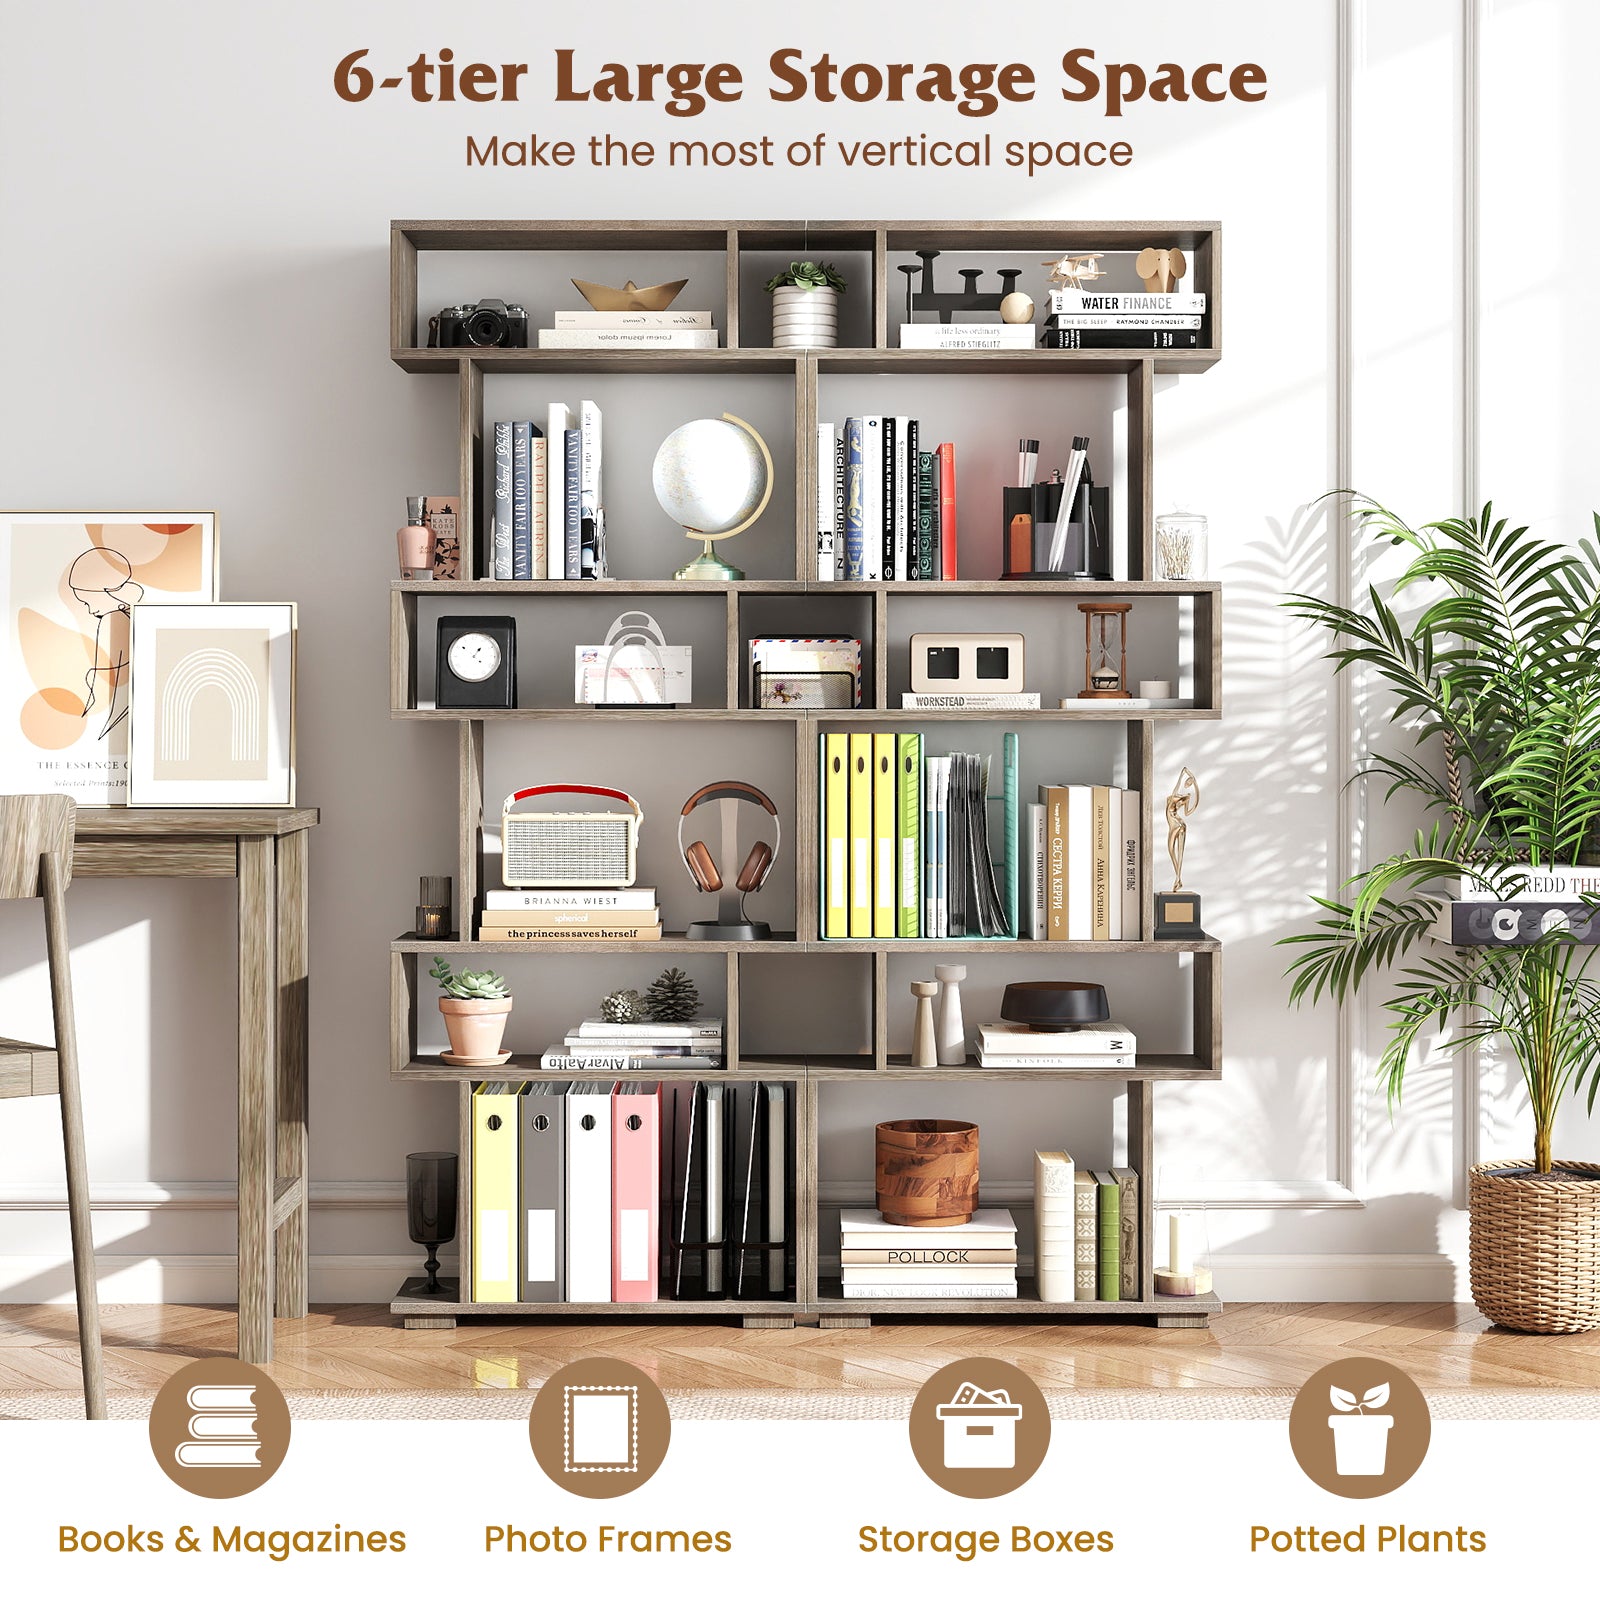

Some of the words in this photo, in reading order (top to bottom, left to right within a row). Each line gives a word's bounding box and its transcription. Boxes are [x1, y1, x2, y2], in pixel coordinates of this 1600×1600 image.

[1081, 297, 1119, 310] WATER
[1123, 297, 1172, 310] FINANCE
[969, 327, 1000, 337] ordinary
[514, 438, 527, 474] YEARS
[568, 432, 579, 473] VANITY
[535, 441, 545, 495] RALPH
[568, 477, 579, 503] FAIR
[836, 437, 845, 540] ARCHITECTURE
[514, 503, 527, 530] FAIR
[514, 535, 527, 577] VANITY
[568, 528, 579, 564] YEARS
[915, 696, 965, 707] WORKSTEAD
[37, 761, 61, 770] THE
[66, 761, 120, 770] ESSENCE
[1052, 837, 1063, 876] СЕСТРА
[1052, 878, 1063, 910] КЕРРИ
[1523, 876, 1566, 893] REDD
[524, 897, 578, 905] BRIANNA
[583, 897, 618, 905] WIEST
[553, 912, 588, 923] spherical
[507, 929, 525, 938] the
[526, 929, 571, 940] princess
[601, 929, 638, 938] herself
[888, 1250, 969, 1263] POLLOCK
[941, 1288, 1009, 1297] REVOLUTION
